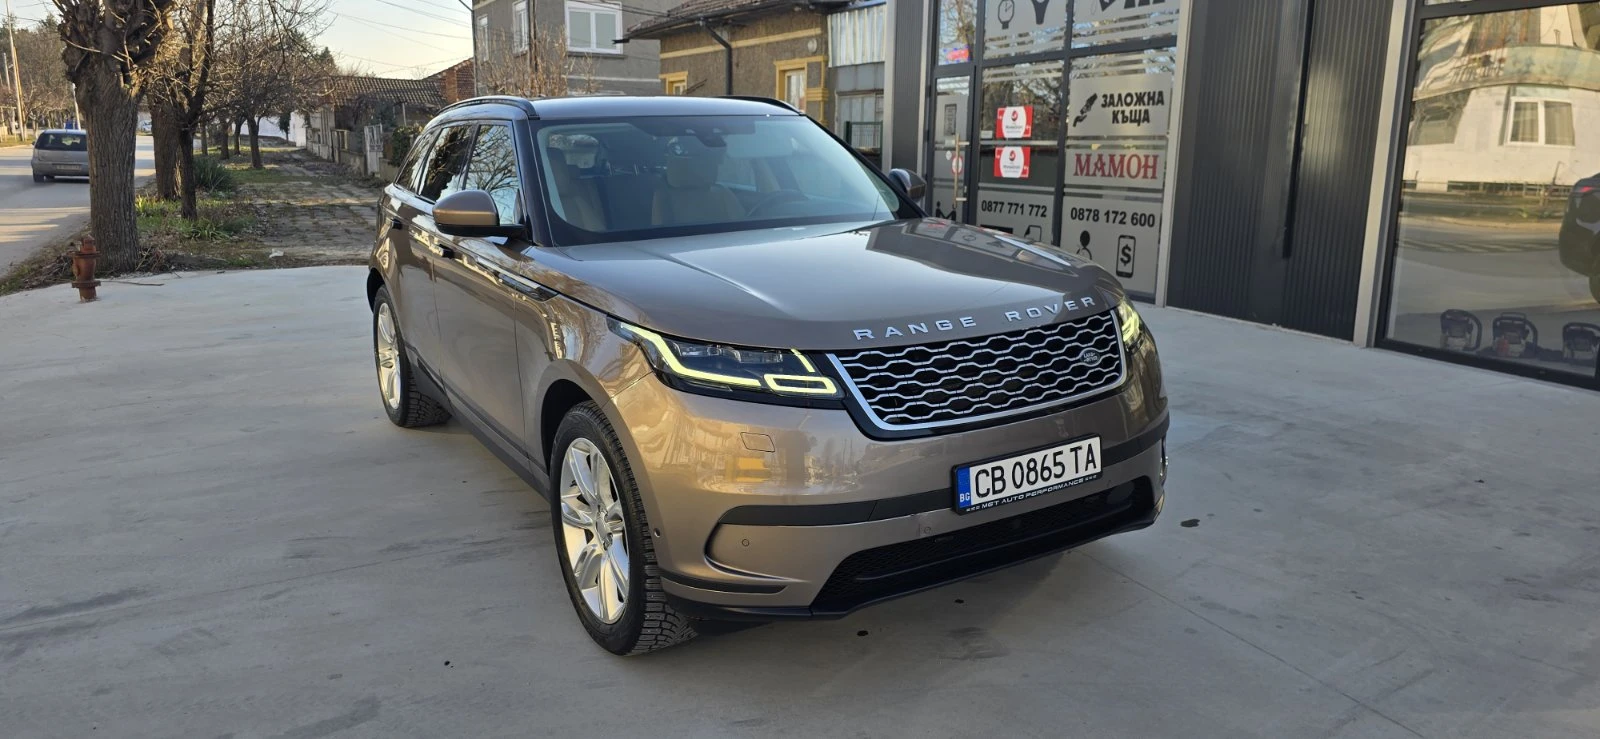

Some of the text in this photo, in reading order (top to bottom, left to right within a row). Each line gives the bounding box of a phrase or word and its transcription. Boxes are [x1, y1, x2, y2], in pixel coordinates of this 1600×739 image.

[1101, 90, 1165, 108] ЗАЛОЖНА
[1112, 109, 1150, 127] КЪЩА
[1073, 153, 1159, 179] МАМОН
[981, 200, 1048, 218] 0877 771 772
[1070, 207, 1156, 228] 0878 172 600
[853, 296, 1096, 341] RANGE ROVER
[975, 443, 1097, 498] CB 0865 TA
[959, 492, 971, 503] BG
[1001, 494, 1024, 504] AUTO
[1025, 477, 1084, 498] PERFORMANCE
